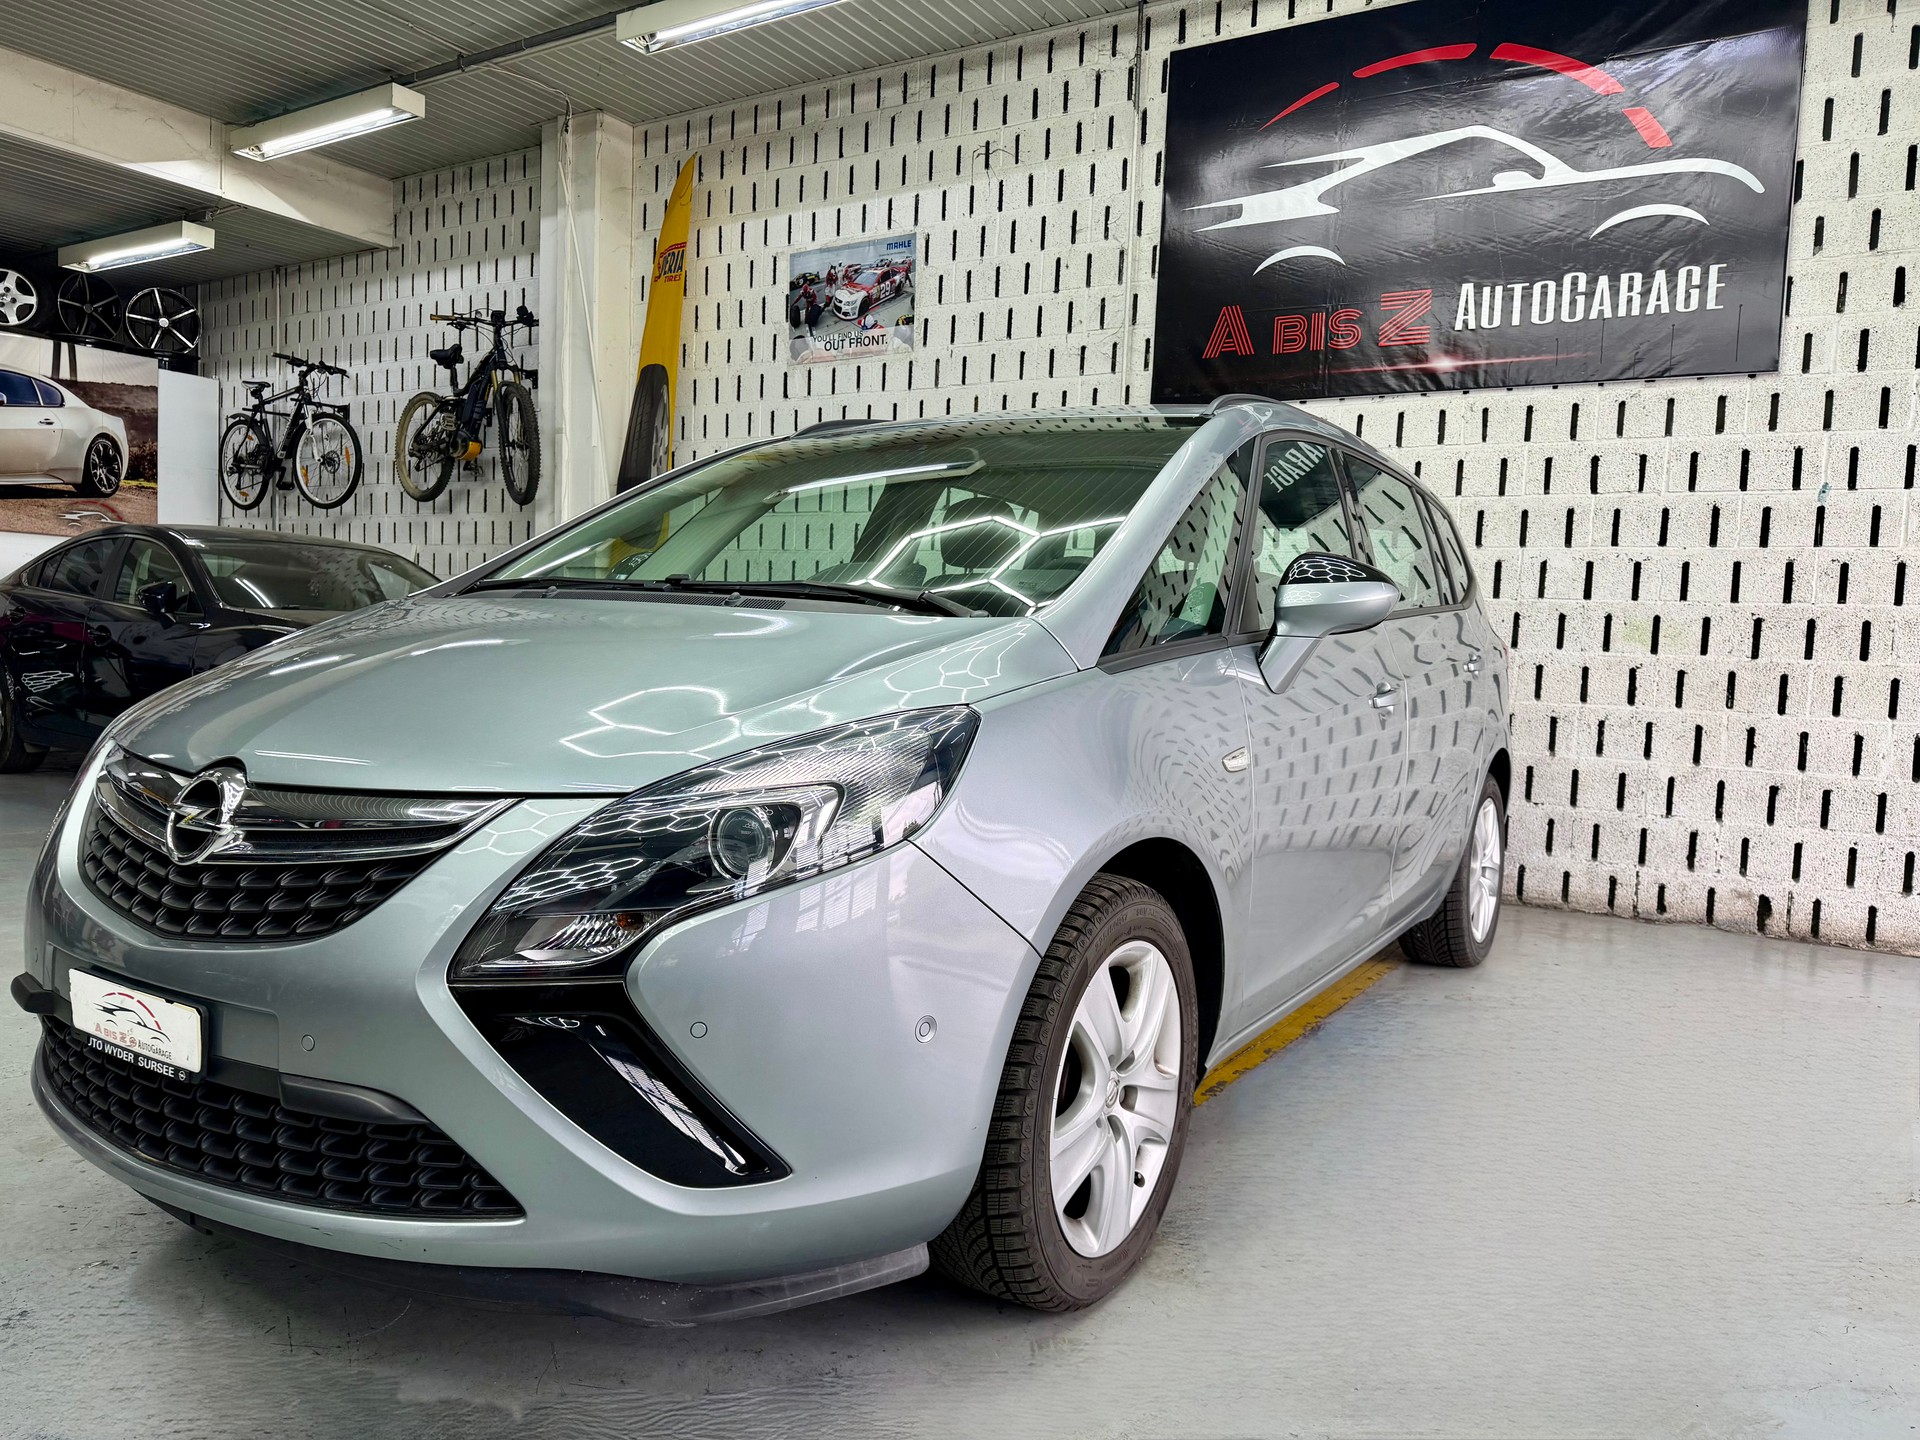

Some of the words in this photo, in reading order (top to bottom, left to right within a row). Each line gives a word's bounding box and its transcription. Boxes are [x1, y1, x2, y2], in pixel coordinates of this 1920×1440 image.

[886, 239, 912, 250] MAHLE
[664, 273, 682, 283] TIRES
[880, 281, 891, 298] 29
[1201, 305, 1255, 359] A
[1272, 309, 1363, 355] BIS
[1378, 288, 1433, 347] Z
[813, 333, 836, 343] YOU'LL
[838, 331, 852, 339] FIND
[854, 330, 864, 338] US
[824, 338, 846, 352] OUT
[849, 334, 888, 348] FRONT.
[95, 1022, 103, 1034] A
[103, 1027, 118, 1041] BIS
[104, 1043, 135, 1064] WYDER
[138, 1056, 175, 1078] SURSEE
